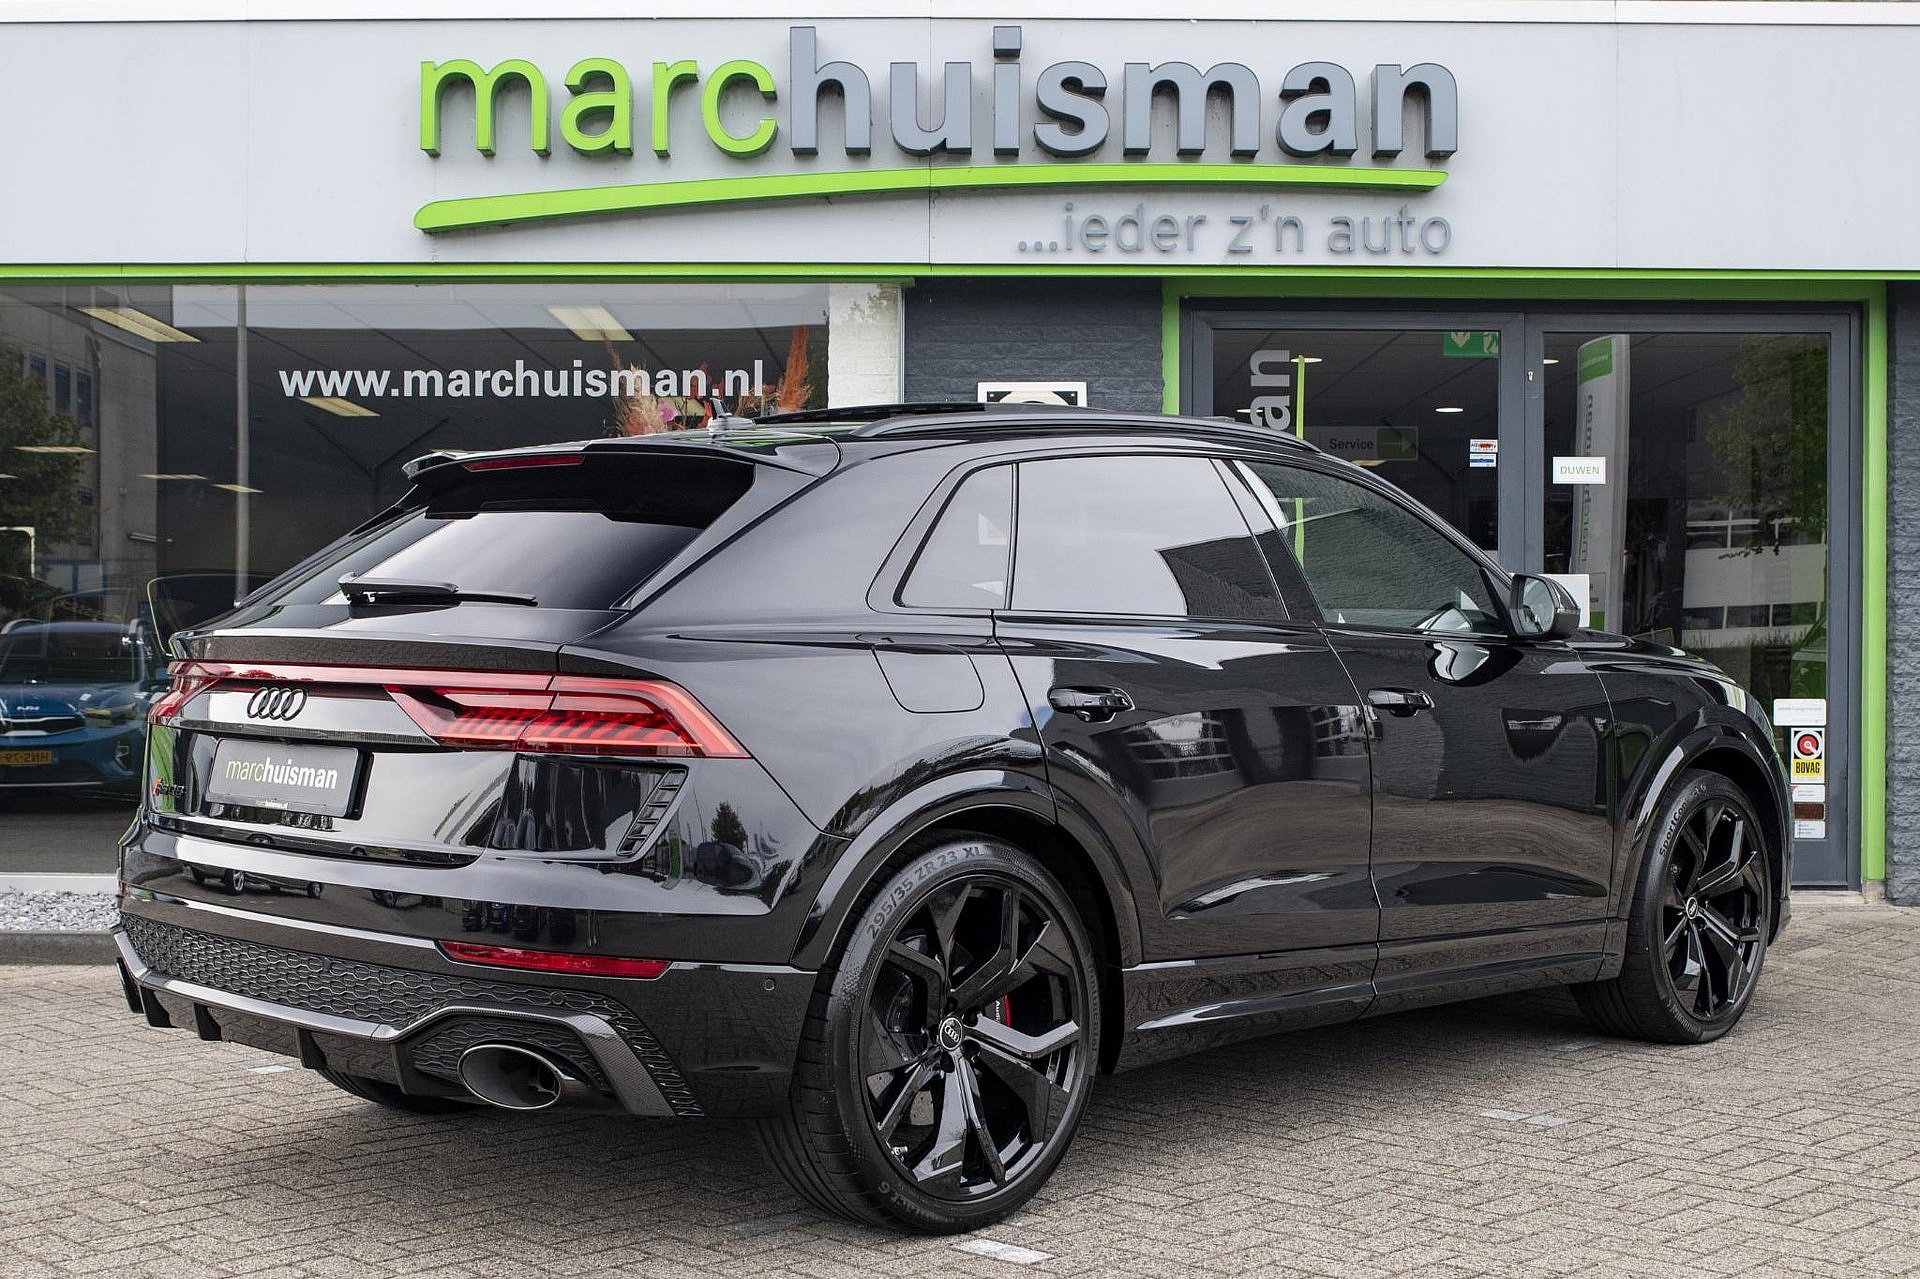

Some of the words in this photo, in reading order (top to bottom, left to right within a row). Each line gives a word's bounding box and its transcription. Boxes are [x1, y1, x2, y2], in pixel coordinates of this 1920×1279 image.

[420, 26, 1459, 158] marchuisman
[1228, 204, 1304, 253] z'n
[1327, 204, 1453, 254] auto
[278, 359, 763, 397] www.marchuisman.nl
[1329, 438, 1374, 449] Service
[1560, 466, 1600, 475] DUWEN
[225, 757, 338, 789] marchuisman
[1795, 762, 1821, 774] BOVAG
[867, 876, 915, 940] 295/35
[914, 862, 937, 879] ZR
[937, 850, 958, 867] 23
[961, 845, 985, 858] XL
